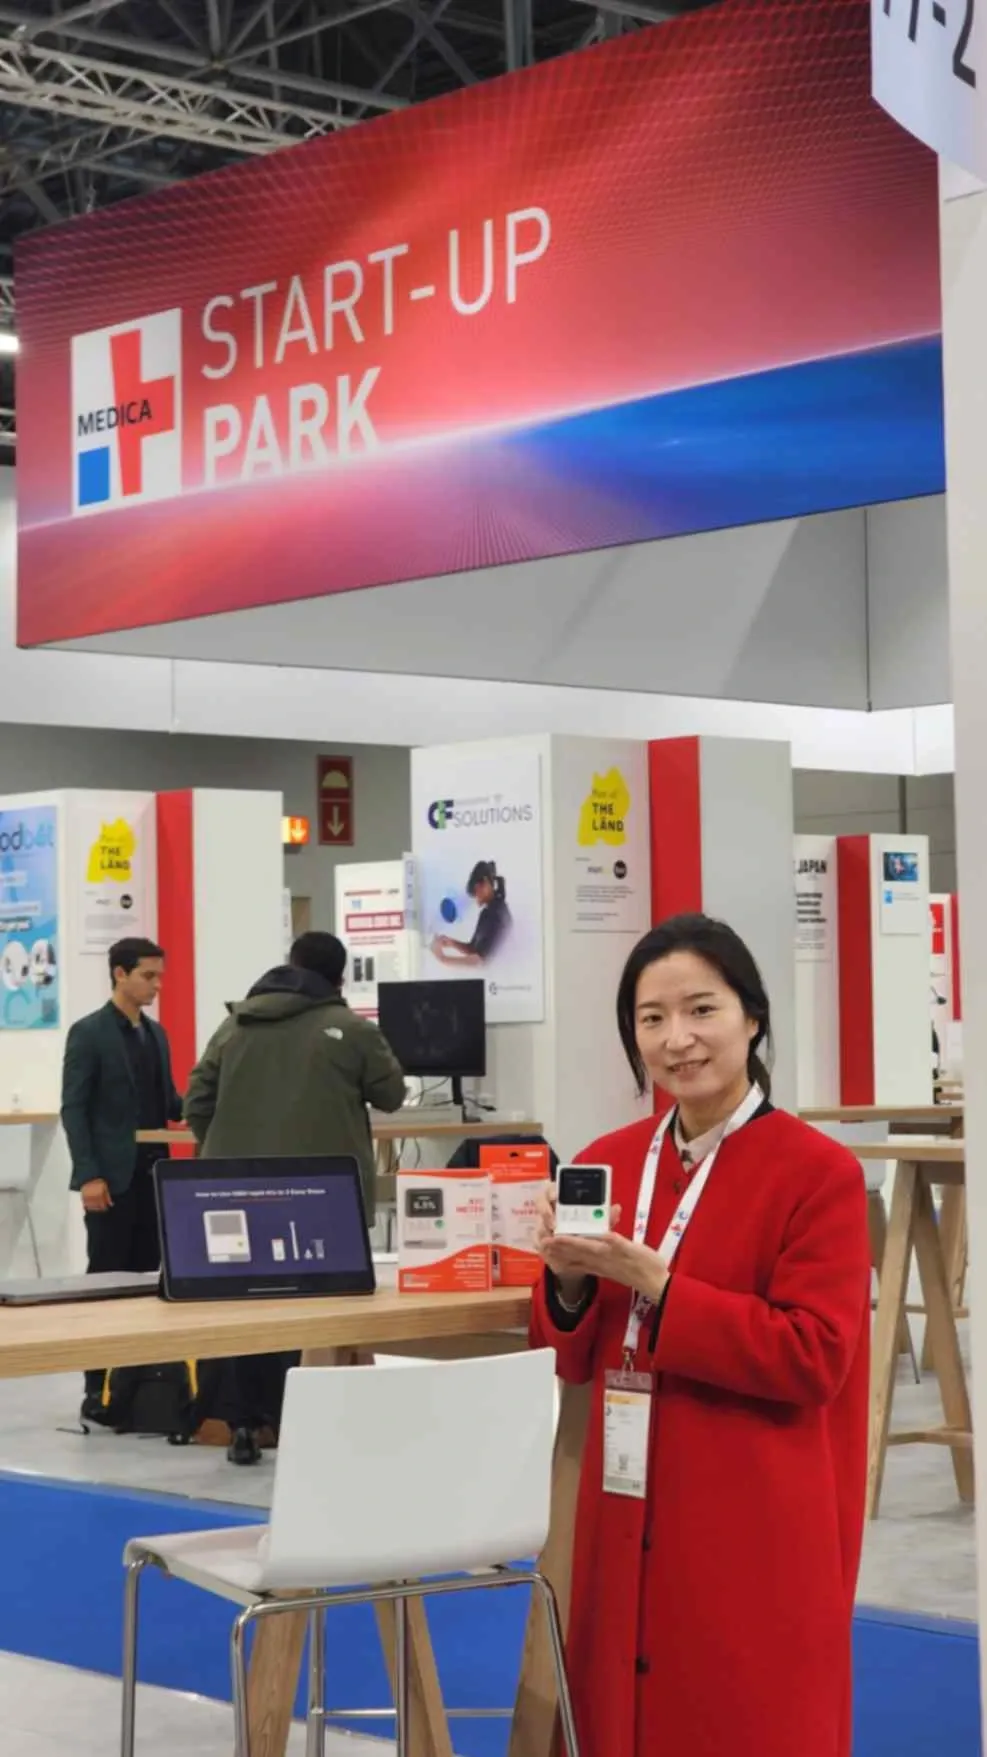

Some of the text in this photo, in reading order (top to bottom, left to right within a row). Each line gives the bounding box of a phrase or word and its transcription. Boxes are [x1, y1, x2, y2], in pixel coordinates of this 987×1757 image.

[201, 206, 551, 380] START-UP
[77, 398, 153, 437] MEDICA
[203, 366, 382, 488] PARK
[453, 804, 534, 829] SOLUTIONS
[592, 802, 614, 816] THE
[100, 846, 121, 857] THE
[798, 860, 828, 874] JAPAN
